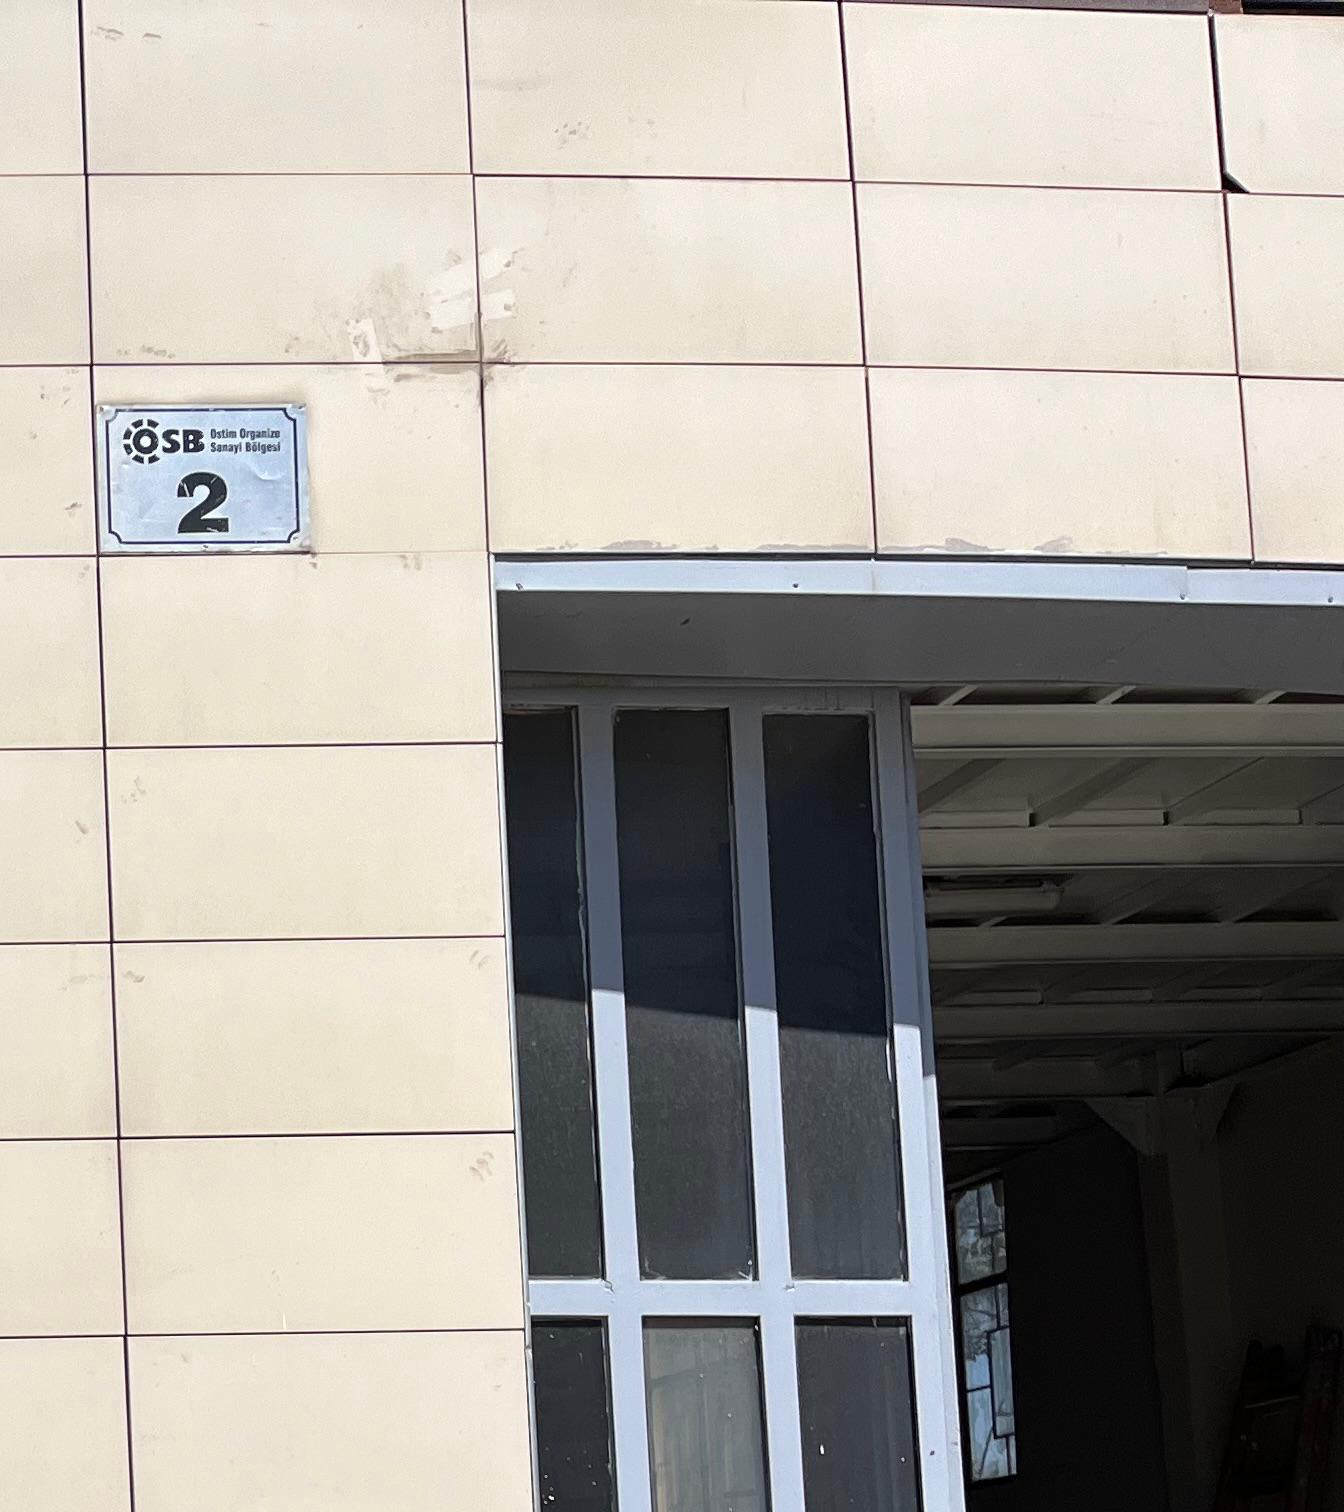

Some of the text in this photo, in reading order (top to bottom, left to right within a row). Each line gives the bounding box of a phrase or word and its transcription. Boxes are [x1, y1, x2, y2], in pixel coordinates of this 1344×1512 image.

[132, 427, 280, 454] OSB Ostim Organize
[210, 441, 281, 455] Sanayi Bölgesi
[177, 472, 229, 533] 2
